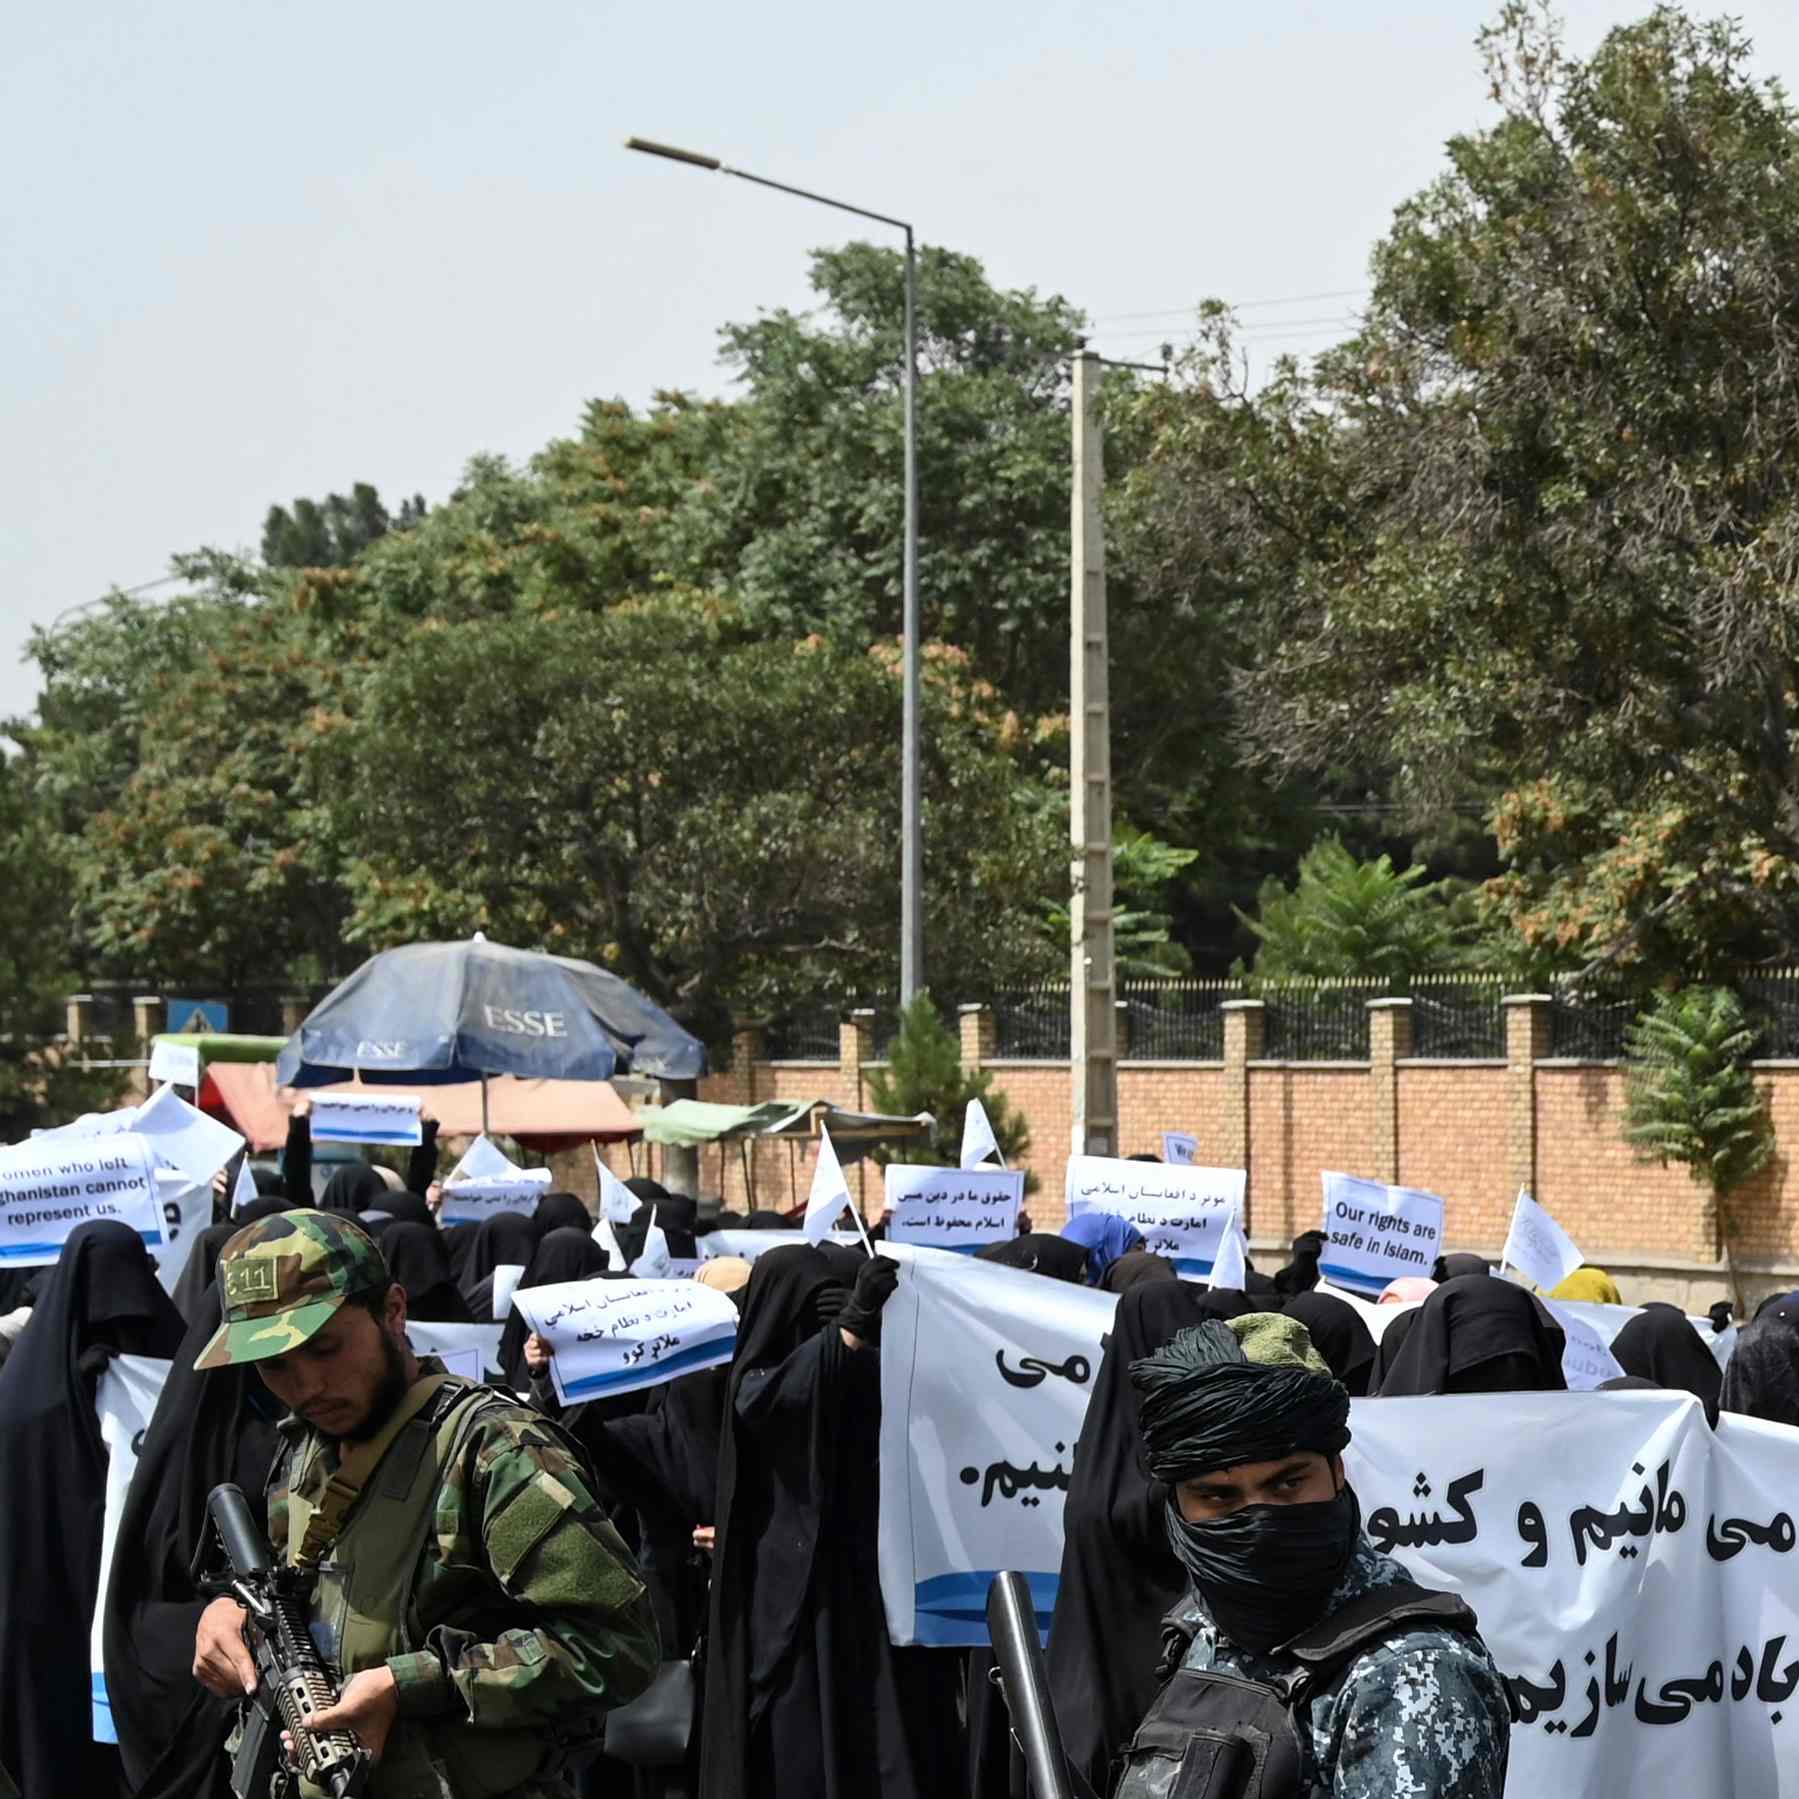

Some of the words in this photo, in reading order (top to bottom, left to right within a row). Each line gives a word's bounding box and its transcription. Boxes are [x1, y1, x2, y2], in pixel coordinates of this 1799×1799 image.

[484, 1005, 567, 1037] ESSE
[2, 1168, 53, 1180] omen
[59, 1162, 94, 1175] who
[86, 1177, 145, 1194] cannot
[8, 1204, 90, 1226] represent
[97, 1203, 122, 1216] us.
[1335, 1201, 1365, 1222] Our
[1368, 1208, 1410, 1233] rights
[1412, 1221, 1437, 1241] are
[1330, 1229, 1364, 1249] safe
[1366, 1236, 1381, 1254] in
[1383, 1241, 1429, 1266] Islam.
[1569, 1459, 1688, 1567] مانیم
[1516, 1499, 1549, 1568] و
[1706, 1510, 1796, 1563] می
[1634, 1655, 1725, 1726] می
